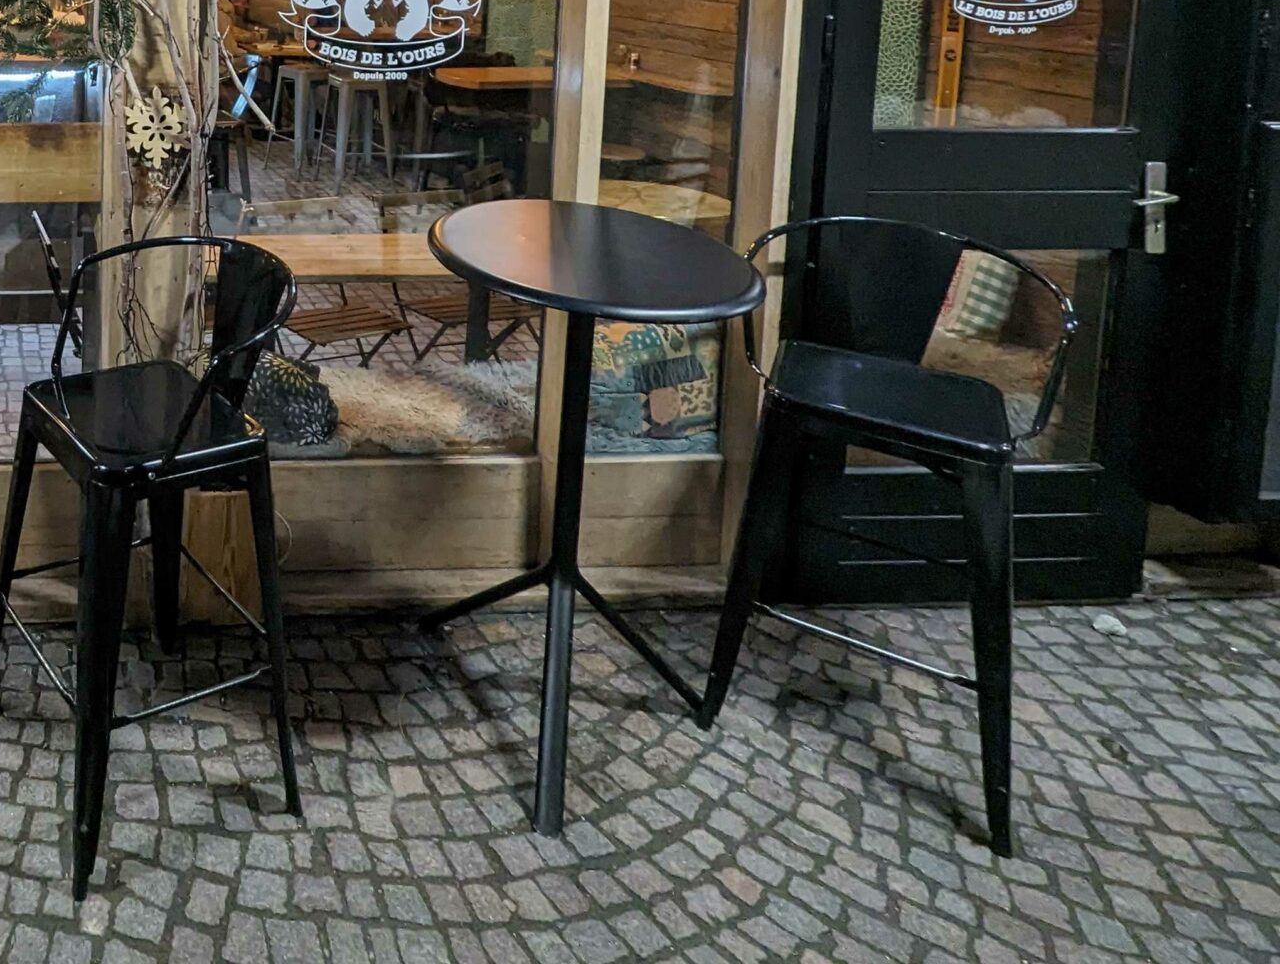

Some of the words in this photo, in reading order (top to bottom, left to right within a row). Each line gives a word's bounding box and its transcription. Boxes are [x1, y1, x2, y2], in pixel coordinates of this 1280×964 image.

[958, 0, 975, 14] LE
[975, 6, 1006, 20] BOIS
[1008, 11, 1025, 21] DE
[1028, 0, 1074, 21] L'OURS
[319, 43, 357, 63] BOIS
[361, 51, 384, 65] DE
[387, 41, 447, 65] L'OURS
[353, 71, 384, 81] Depuis
[385, 71, 408, 81] 2009
